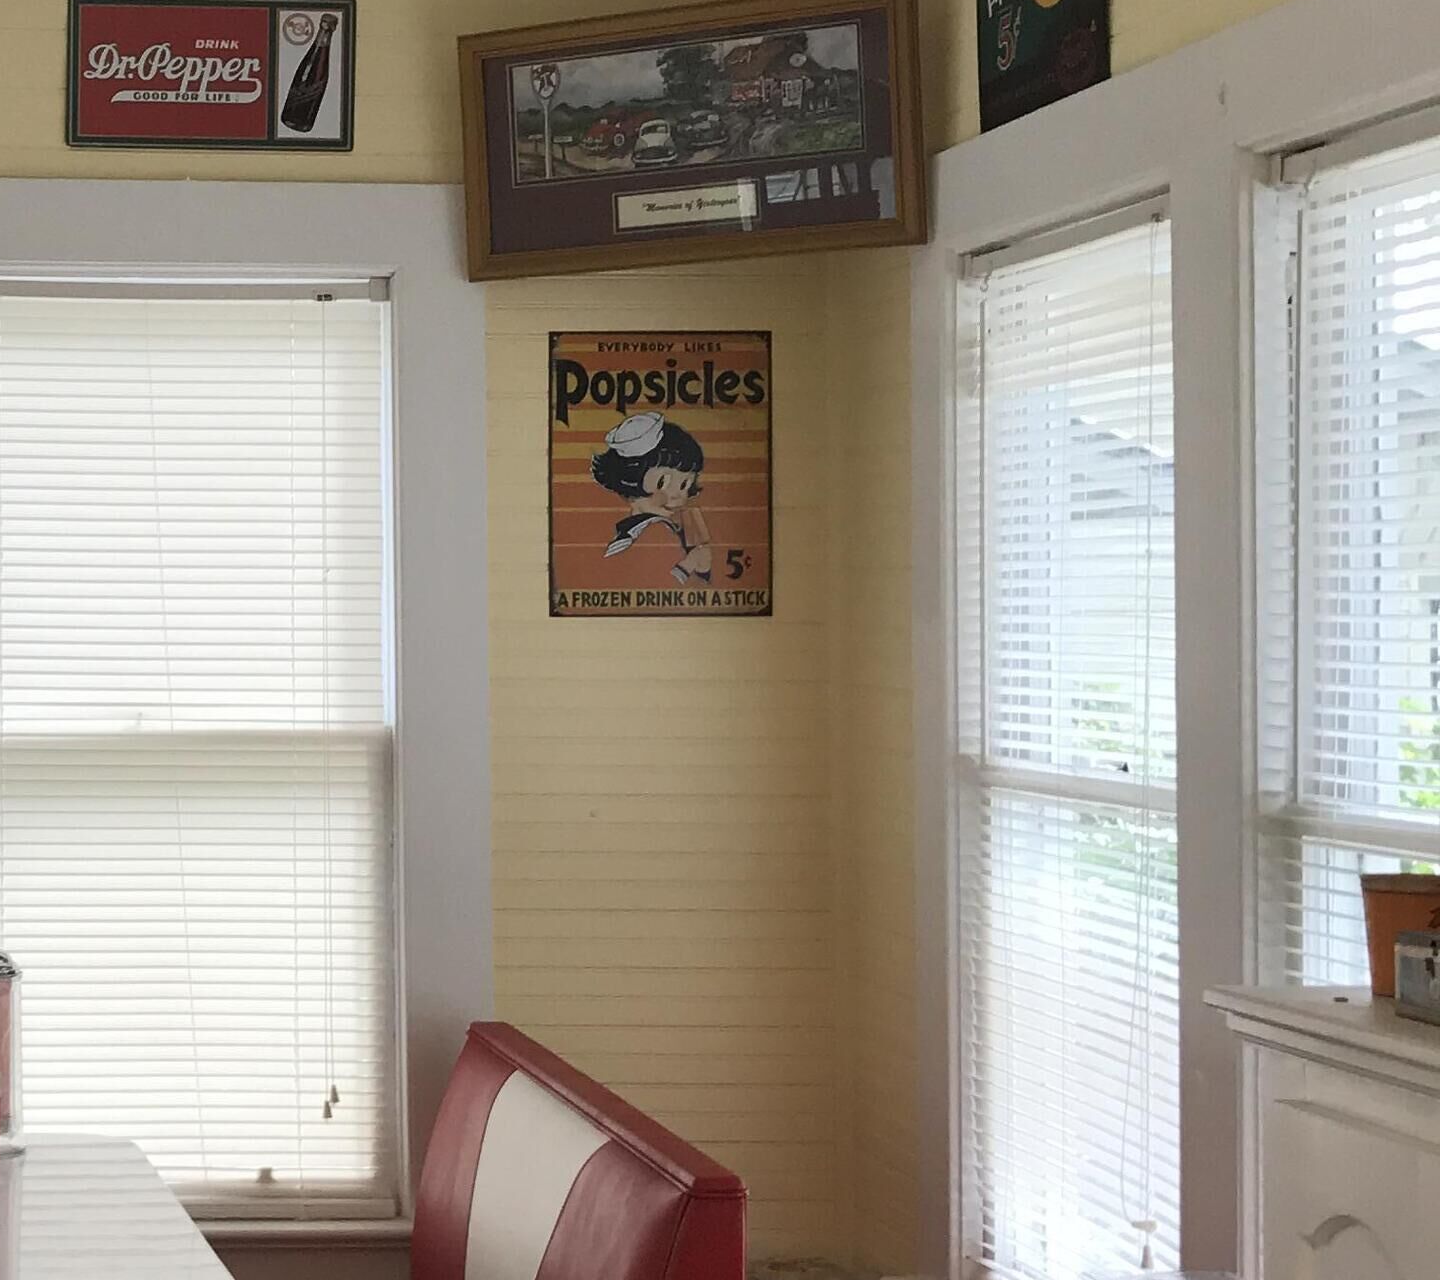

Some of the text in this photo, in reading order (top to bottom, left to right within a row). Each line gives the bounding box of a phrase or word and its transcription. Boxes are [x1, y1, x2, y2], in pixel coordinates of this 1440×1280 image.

[195, 39, 239, 50] DRINK
[133, 91, 168, 102] GOOD
[175, 92, 198, 102] FOR
[597, 342, 722, 353] EVERYBODY LIKES
[552, 358, 766, 427] Popsicles
[558, 589, 766, 608] A FROZEN DRINK ON A STICK
